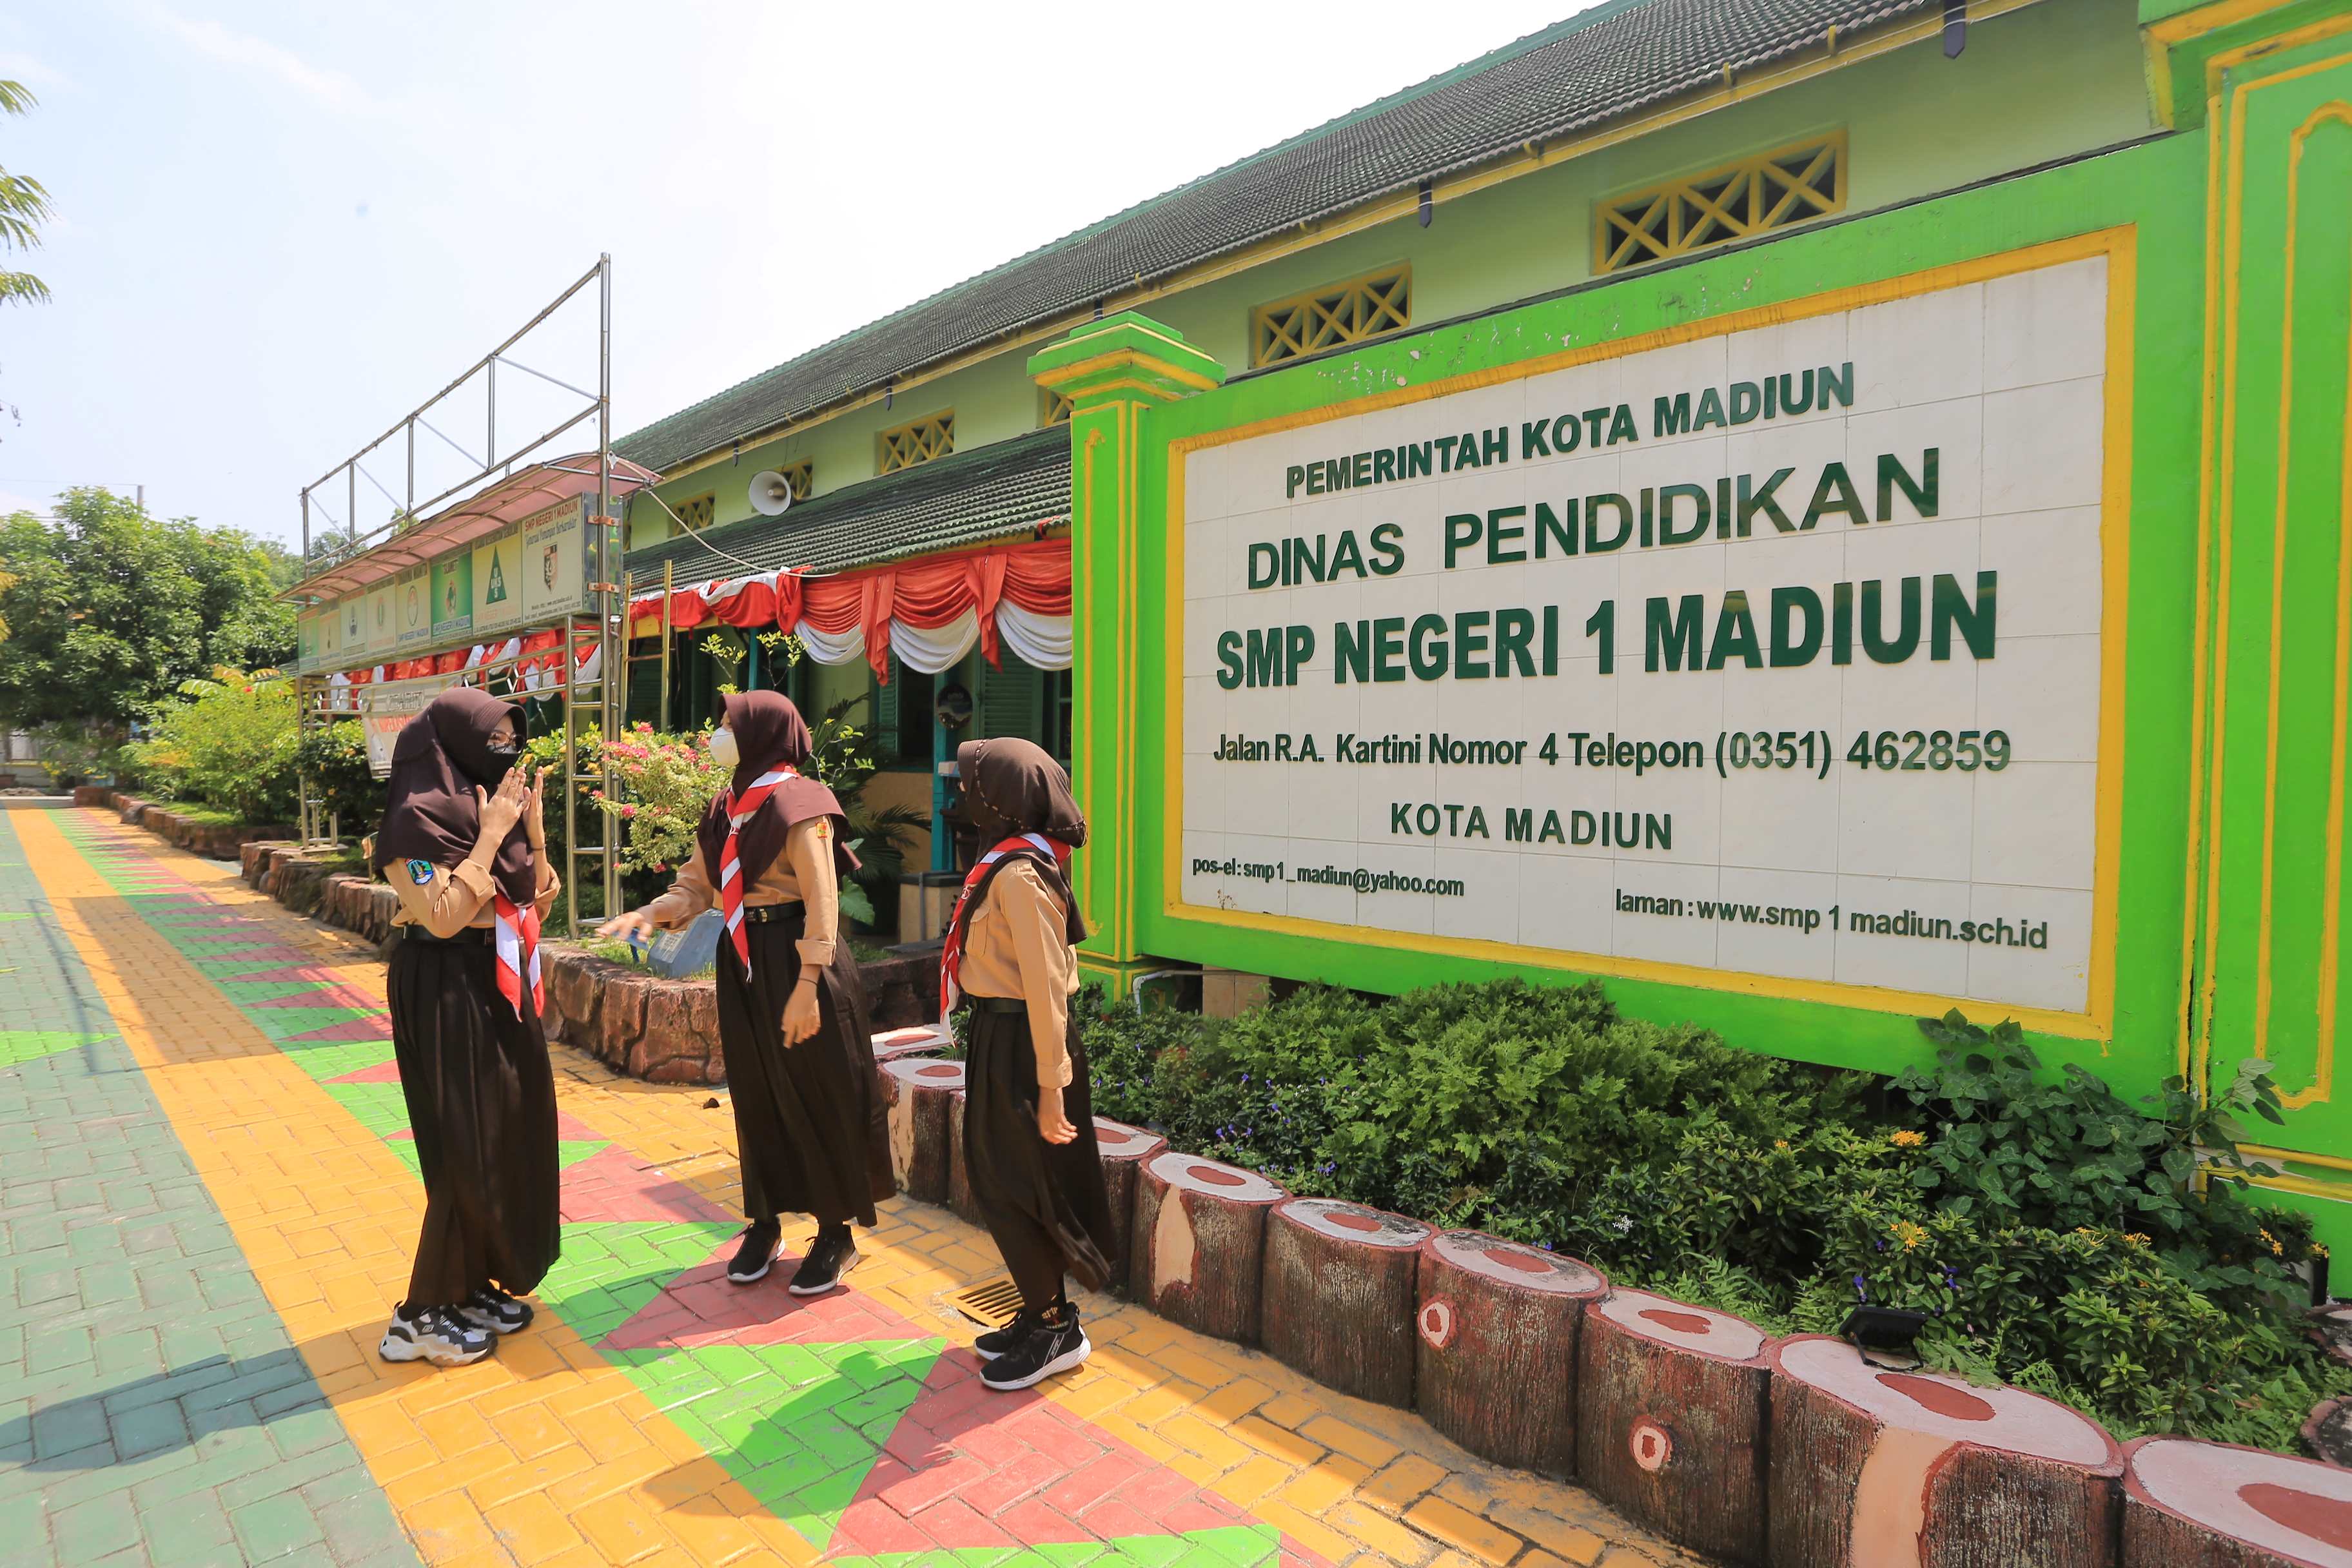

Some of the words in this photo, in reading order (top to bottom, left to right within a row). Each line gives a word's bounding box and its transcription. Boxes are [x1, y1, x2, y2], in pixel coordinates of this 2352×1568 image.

[1286, 426, 1509, 500] PEMERINTAH
[1522, 403, 1639, 460] KOTA
[1654, 361, 1855, 439] MADIUN
[525, 518, 535, 532] SMP
[536, 510, 553, 527] NEGERI
[557, 499, 578, 518] MADIUN
[1248, 523, 1406, 591] DINAS
[1444, 447, 1940, 571] PENDIDIKAN
[1216, 625, 1316, 691] SMP
[1334, 605, 1560, 685] NEGERI
[1585, 600, 1615, 676] 1
[1645, 570, 1998, 674] MADIUN
[1213, 733, 1271, 762] Jalan
[1274, 733, 1324, 763] R.A.
[1336, 733, 1422, 765] Kartini
[1428, 732, 1529, 766] Nomor
[1538, 732, 1563, 766] 4
[1567, 732, 1705, 778] Telepon
[1715, 730, 1833, 780] (0351)
[1845, 729, 2012, 772] 462859
[1391, 802, 1491, 840] KOTA
[1505, 807, 1672, 851] MADIUN
[1850, 909, 2049, 950] madiun.sch.id
